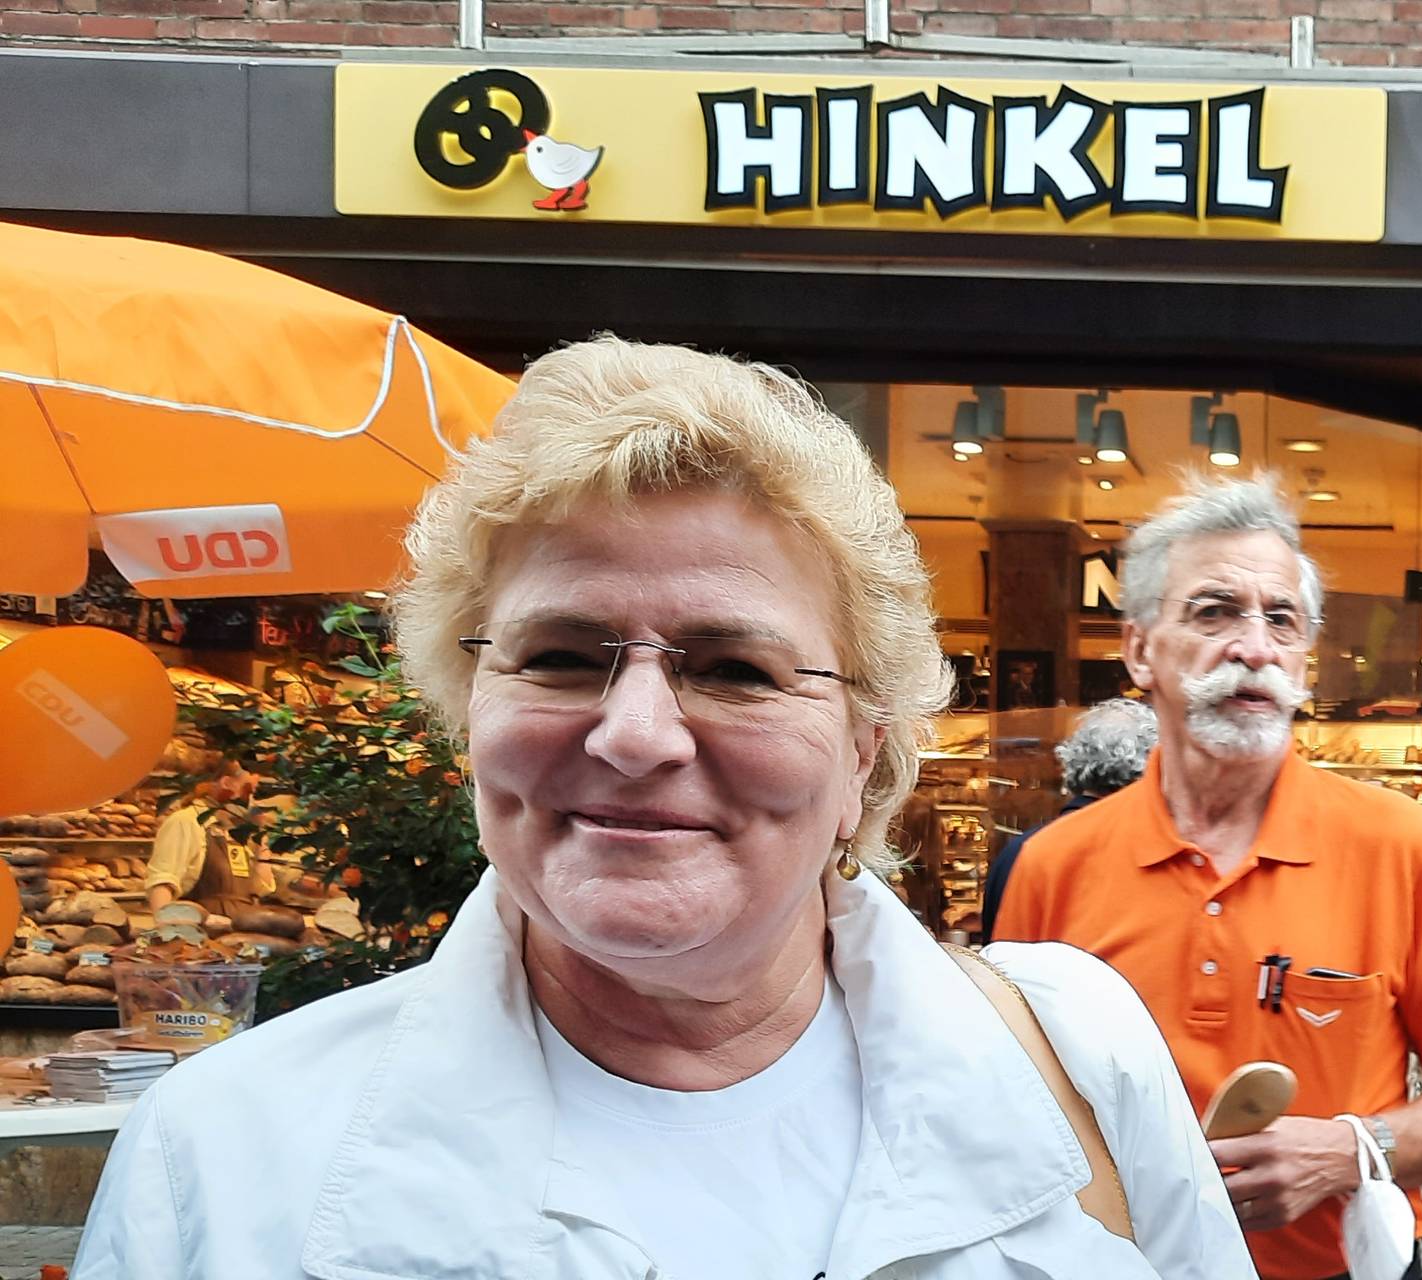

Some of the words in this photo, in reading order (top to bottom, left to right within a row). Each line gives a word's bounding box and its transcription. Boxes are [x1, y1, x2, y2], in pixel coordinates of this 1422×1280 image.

[699, 85, 1289, 222] HINKEL
[23, 682, 86, 727] CDU
[155, 1013, 207, 1026] HARIBO
